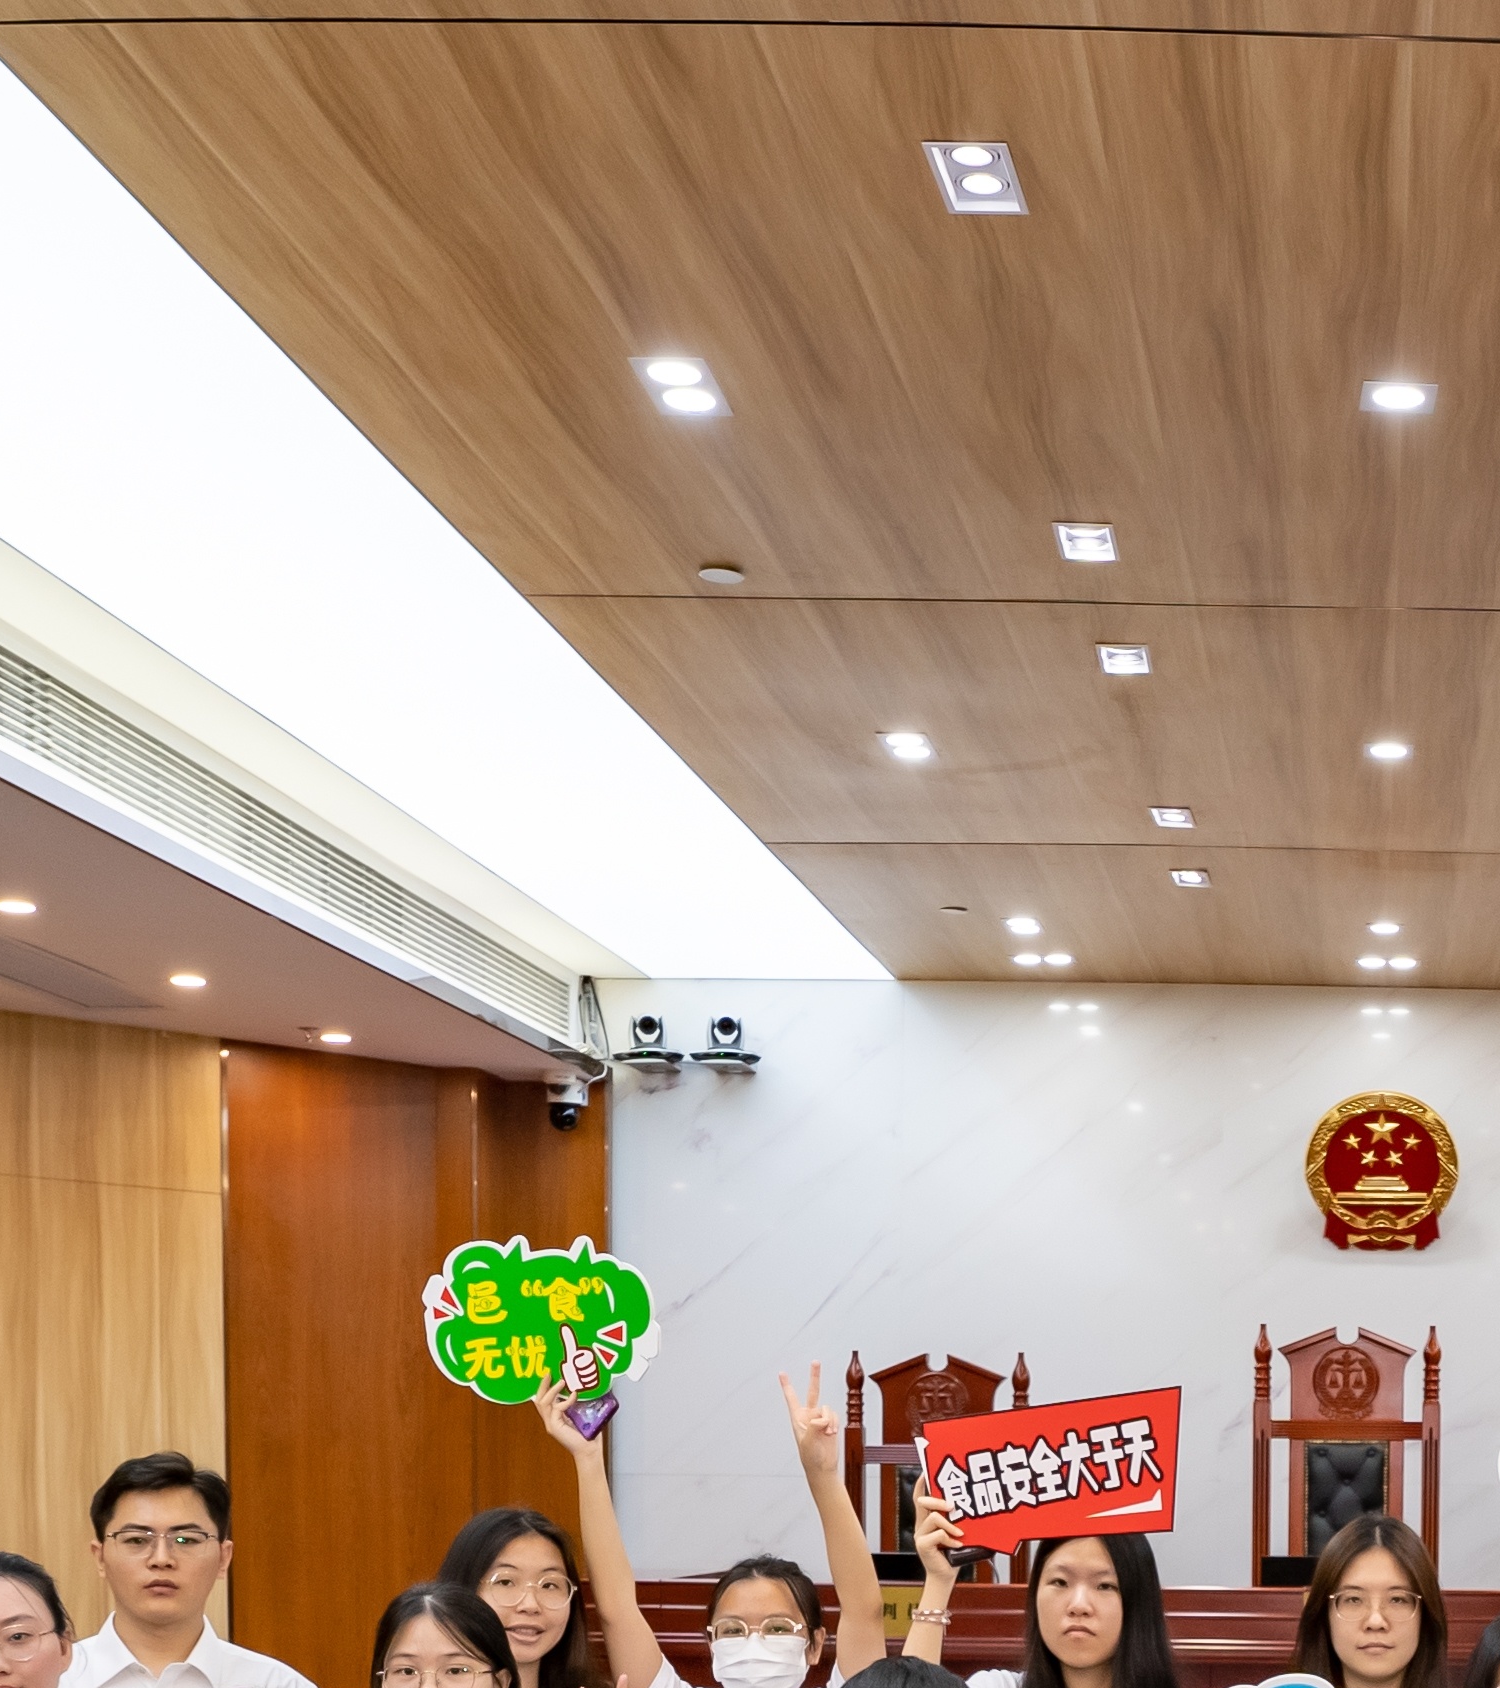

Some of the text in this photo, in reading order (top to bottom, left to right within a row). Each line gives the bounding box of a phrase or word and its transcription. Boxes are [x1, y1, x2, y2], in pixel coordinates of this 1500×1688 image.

[462, 1335, 551, 1380] 无忧
[937, 1418, 1162, 1523] 食品安全大于天
